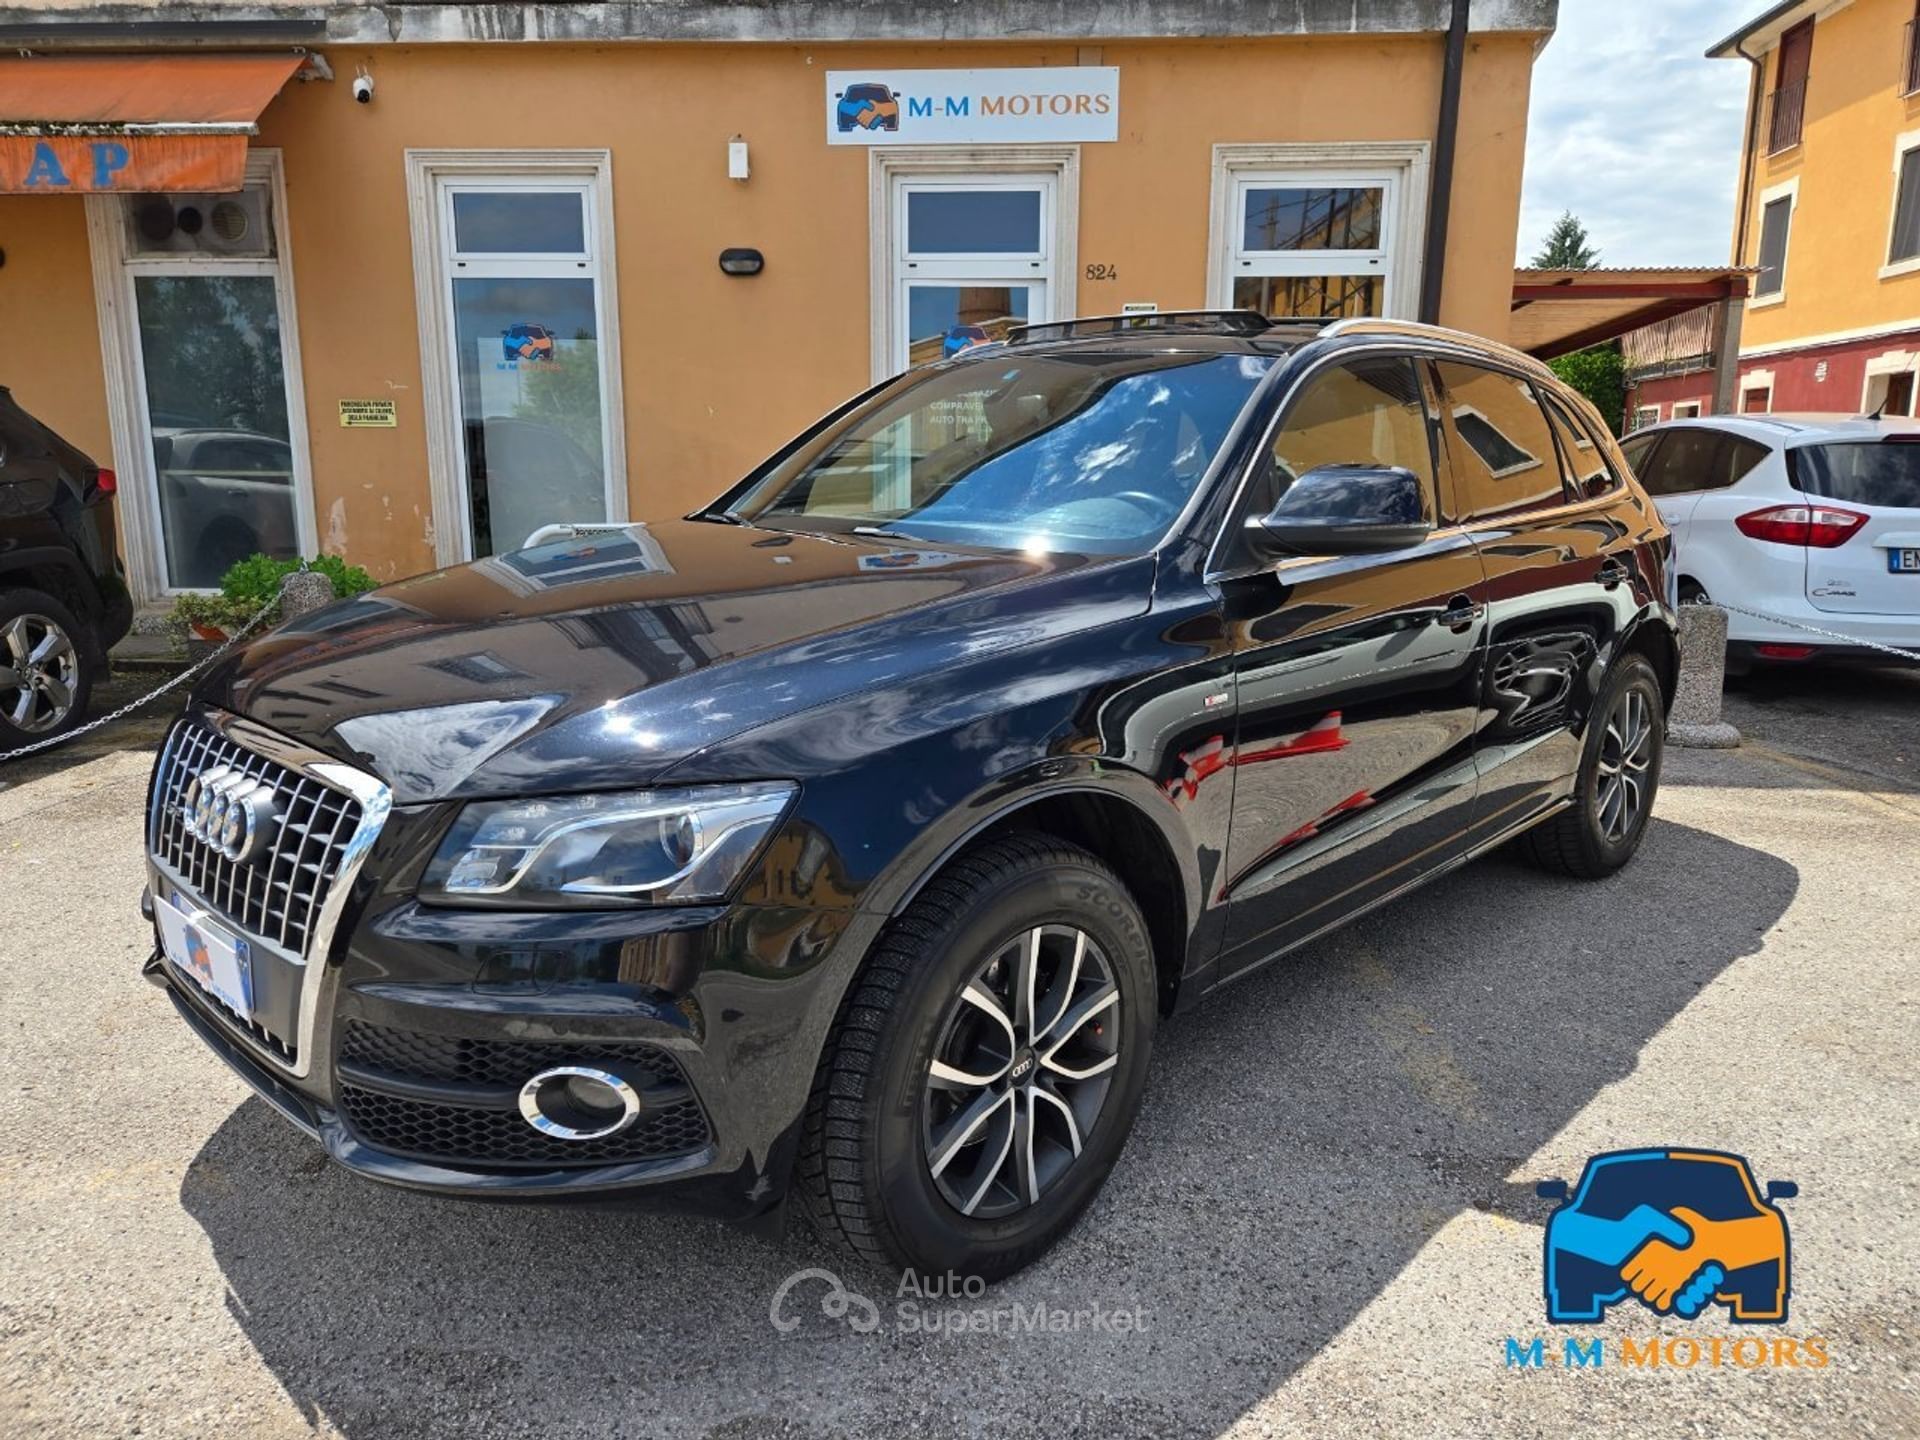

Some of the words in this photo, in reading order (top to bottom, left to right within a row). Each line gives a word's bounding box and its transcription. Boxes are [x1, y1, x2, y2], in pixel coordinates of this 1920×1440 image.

[908, 96, 969, 117] M-M
[981, 94, 1111, 115] MOTORS
[1086, 263, 1117, 280] 824
